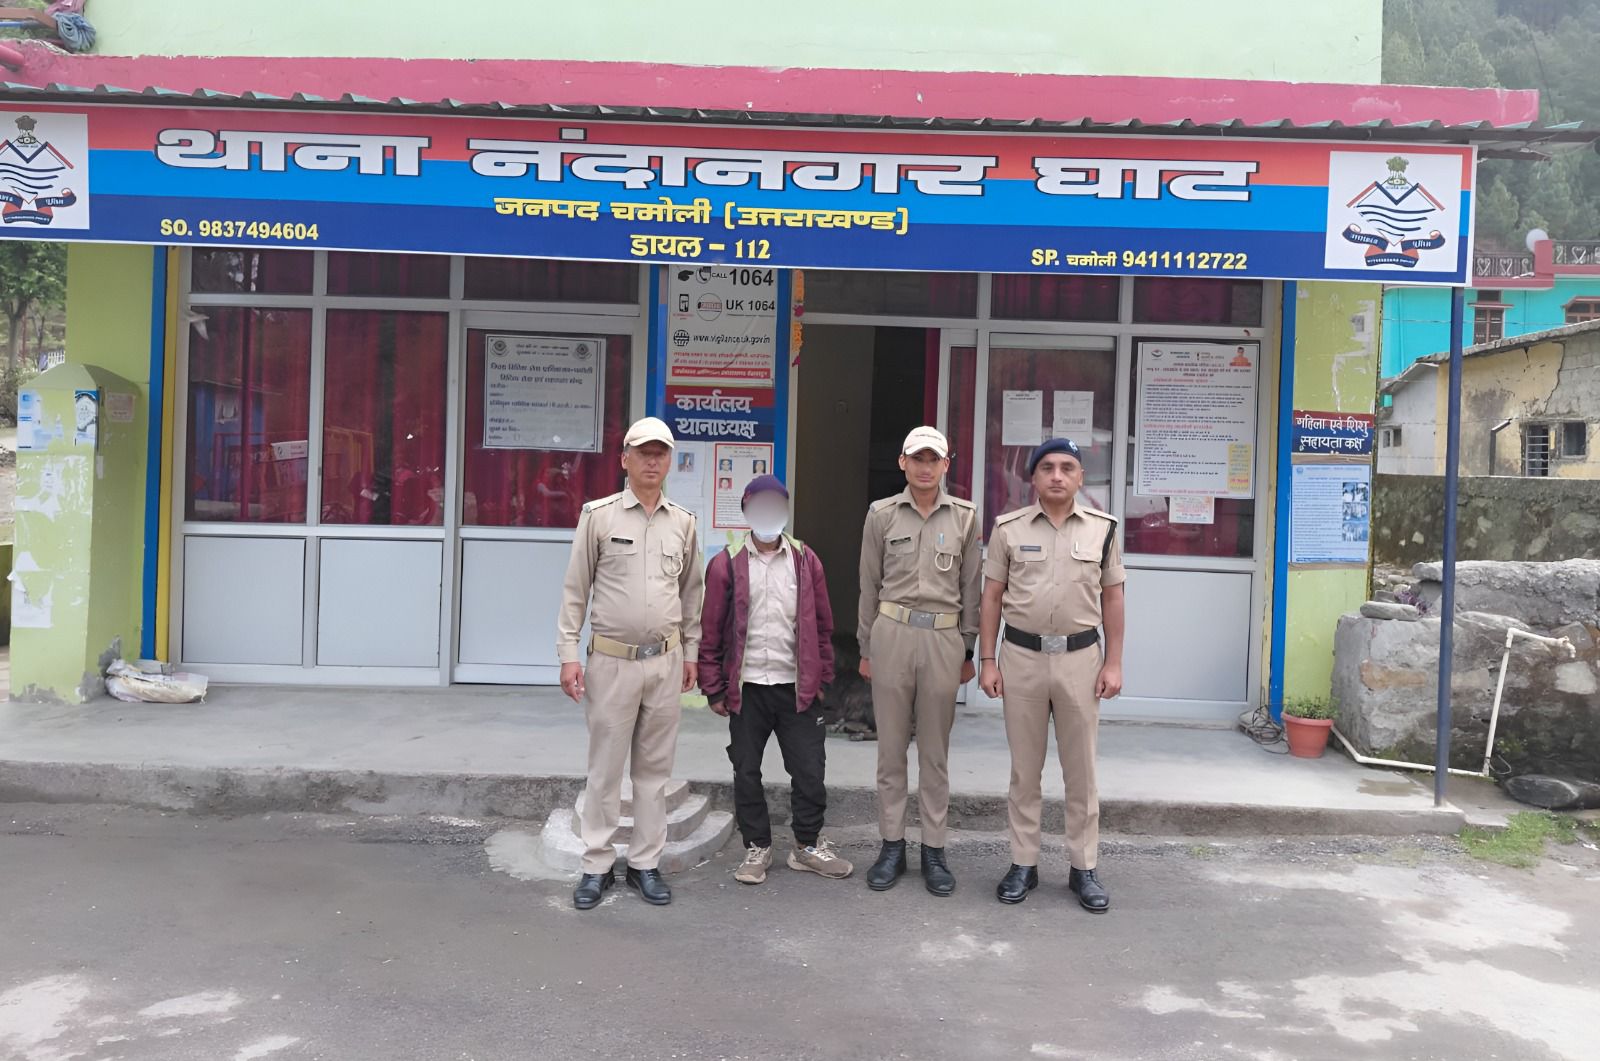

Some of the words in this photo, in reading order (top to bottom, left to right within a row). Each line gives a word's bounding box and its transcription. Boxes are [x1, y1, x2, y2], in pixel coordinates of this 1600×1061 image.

[155, 128, 432, 176] थाना
[468, 127, 998, 196] नंदानगर
[1033, 156, 1260, 202] घाट
[494, 197, 600, 220] जनपद
[611, 197, 711, 225] चमोली
[160, 218, 193, 236] SO.
[199, 219, 319, 240] 9837494604
[630, 234, 703, 258] डायल
[735, 239, 771, 259] 112
[1031, 249, 1060, 266] SP.
[1066, 251, 1117, 267] चमोली
[1122, 251, 1248, 270] 9411112722
[729, 268, 774, 286] 1064
[726, 299, 744, 311] UK
[748, 300, 775, 311] 1064
[674, 389, 753, 414] कार्यालय
[675, 418, 758, 439] थानाध्यक्ष
[1296, 415, 1325, 430] महिला
[1330, 416, 1343, 434] एवं
[1346, 416, 1369, 436] शिशु
[1300, 435, 1342, 450] सहायता
[1343, 437, 1364, 451] कक्ष
